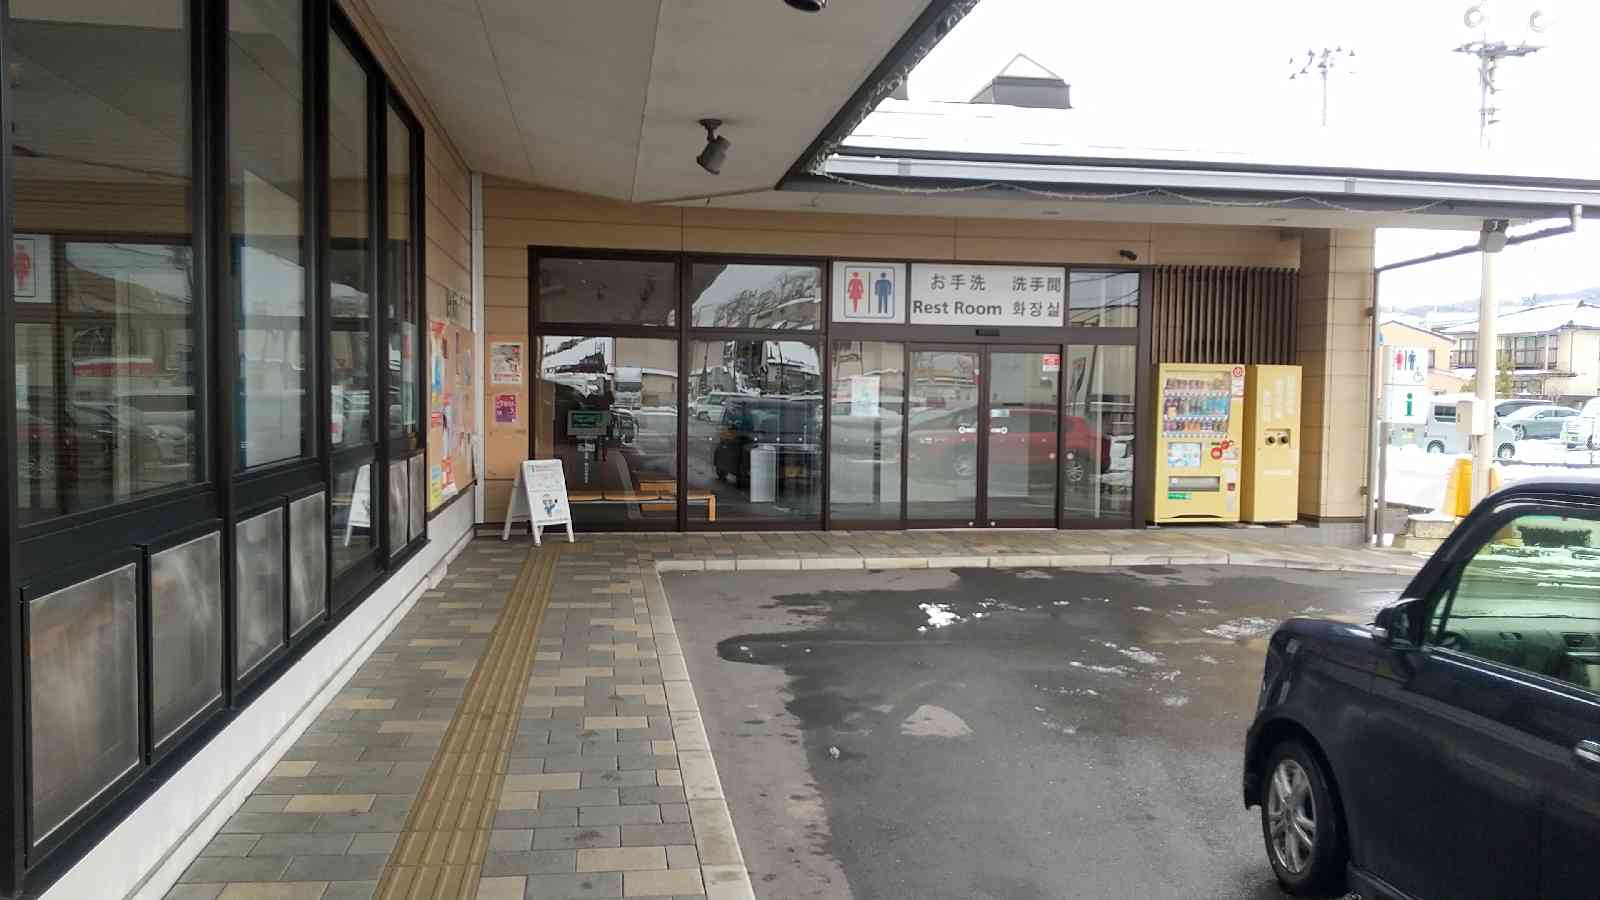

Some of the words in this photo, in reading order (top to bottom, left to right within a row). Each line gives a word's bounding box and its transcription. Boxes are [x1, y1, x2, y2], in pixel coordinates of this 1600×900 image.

[931, 273, 986, 291] お手洗
[912, 300, 949, 314] Rest
[954, 301, 1002, 315] Room
[1012, 301, 1060, 317] 화장실
